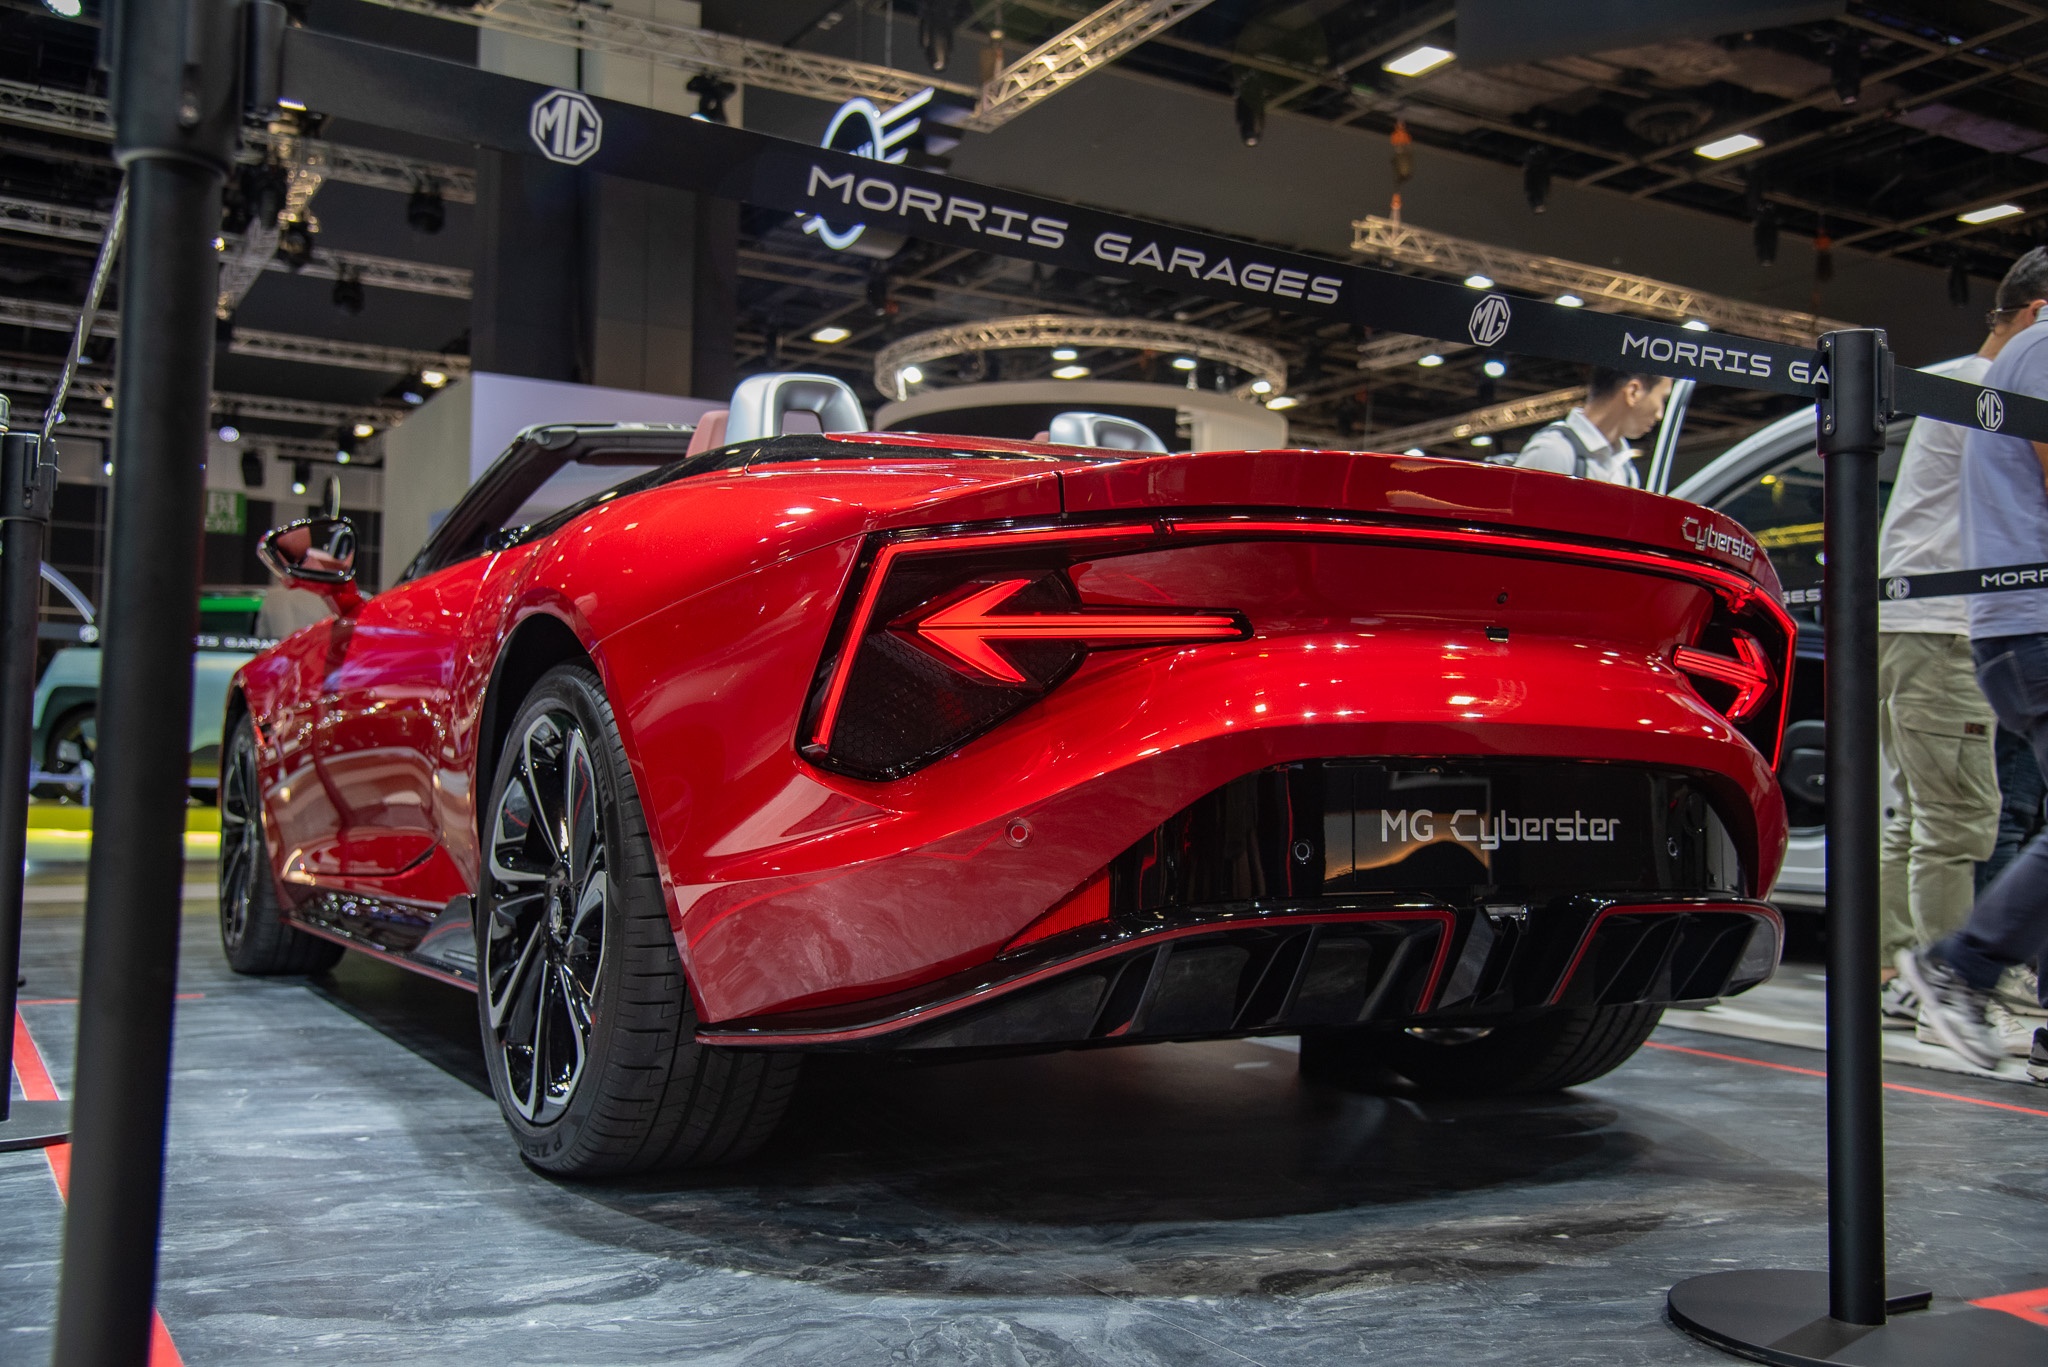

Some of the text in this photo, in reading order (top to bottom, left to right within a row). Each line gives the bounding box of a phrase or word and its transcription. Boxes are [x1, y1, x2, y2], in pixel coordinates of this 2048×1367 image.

[535, 93, 599, 161] MG
[807, 165, 1343, 304] MORRIS GARAGES
[1471, 298, 1508, 342] MG
[1621, 332, 1772, 378] MORRIS
[1979, 392, 2002, 429] MG
[1681, 516, 1755, 562] Cyberster
[1380, 809, 1621, 850] MG Cyberster
